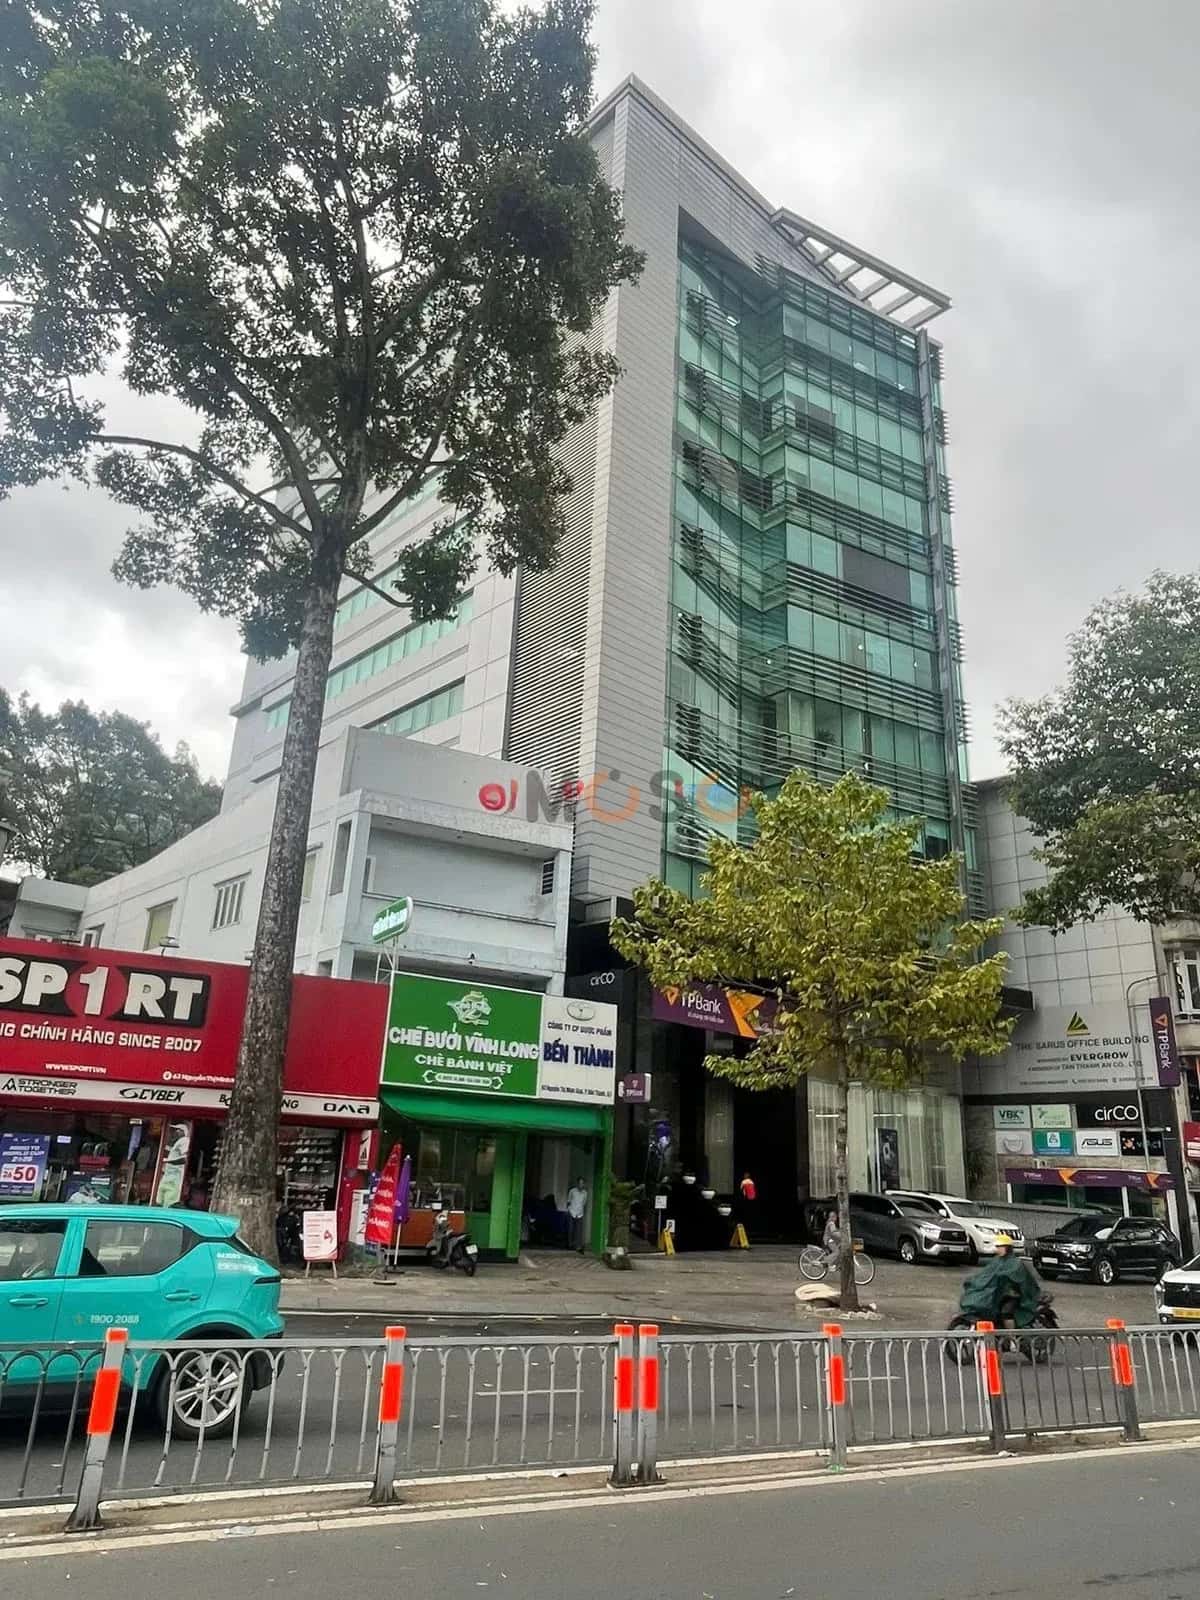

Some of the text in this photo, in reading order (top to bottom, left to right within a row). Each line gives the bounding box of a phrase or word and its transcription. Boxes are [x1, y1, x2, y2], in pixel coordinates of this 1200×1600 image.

[20, 1021, 66, 1041] CHÍNH
[71, 1025, 115, 1045] HÃNG
[118, 1033, 162, 1050] SINCE
[164, 1036, 202, 1053] 2007
[1067, 1037, 1100, 1048] OFFICE
[465, 1032, 499, 1056] VĨNH
[498, 1040, 539, 1060] LONG
[543, 1037, 614, 1069] BẾN THÀNH
[1157, 1030, 1172, 1069] TPBank
[1070, 1051, 1129, 1062] EVERGROW
[446, 1056, 484, 1071] BÁNH
[487, 1060, 513, 1076] VIỆT
[18, 1078, 78, 1088] STRONGER
[18, 1085, 77, 1096] TOGETHER
[138, 1088, 186, 1103] CYBEX
[1095, 1105, 1139, 1121] cirCO
[1081, 1138, 1113, 1147] ASUS
[13, 1166, 36, 1181] 50
[90, 1314, 114, 1324] 1900
